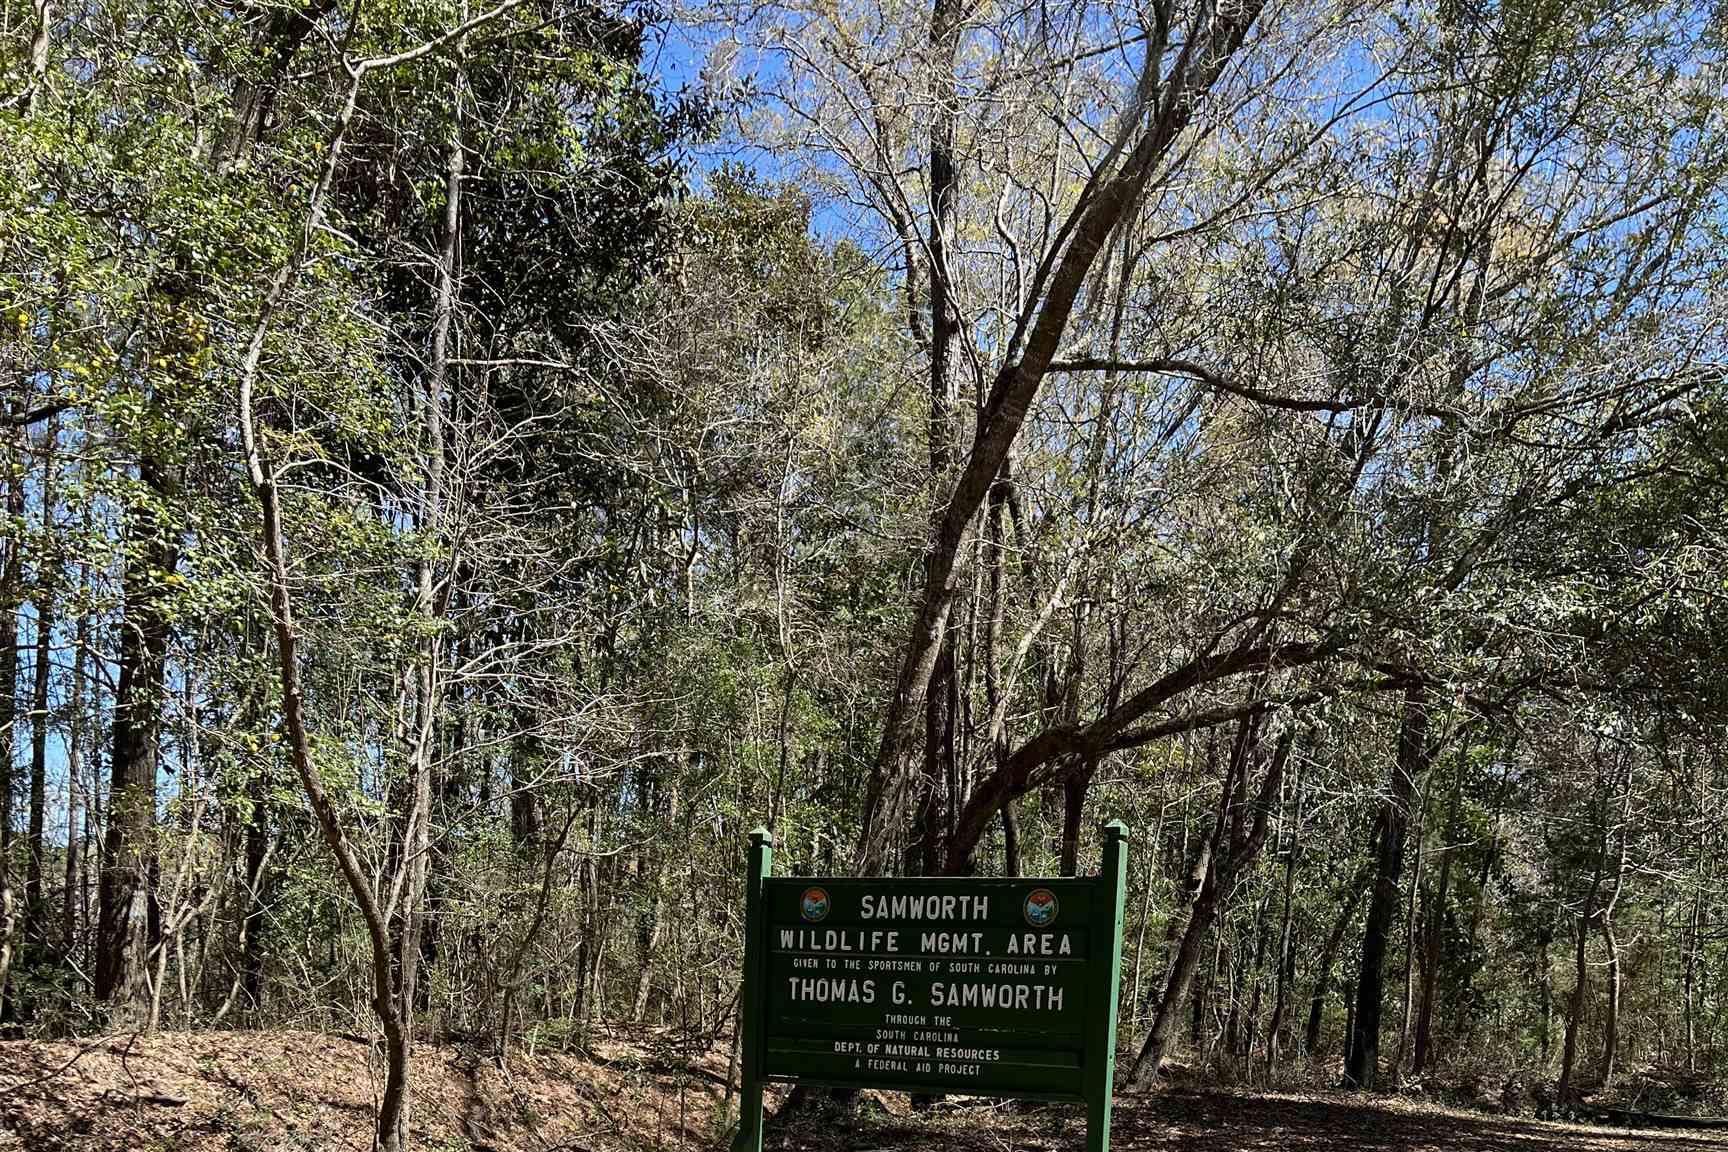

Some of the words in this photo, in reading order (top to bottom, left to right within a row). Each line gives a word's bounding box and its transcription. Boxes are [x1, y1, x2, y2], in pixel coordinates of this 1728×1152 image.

[860, 895, 988, 920] SAMWORTH
[780, 930, 899, 951] WILDLIFE
[921, 933, 991, 955] MGMT.
[1008, 934, 1071, 955] AREA
[793, 958, 818, 968] GIVEN
[826, 959, 836, 969] TO
[845, 959, 861, 970] THE
[868, 960, 921, 972] SPORTSMEN
[929, 962, 940, 972] OF
[949, 962, 980, 973] SOUTH
[988, 963, 1036, 975] CAROLINA
[1045, 965, 1057, 975] BY
[789, 977, 876, 1003] THOMAS
[892, 981, 913, 1005] G.
[931, 983, 1063, 1011] SAMWORTH
[885, 1014, 926, 1025] THROUGH
[934, 1015, 951, 1026] THE
[876, 1030, 906, 1041] SOUTH
[913, 1031, 959, 1043] CAROLINA
[834, 1042, 862, 1053] DEPT.
[867, 1044, 881, 1054] OF
[885, 1045, 930, 1057] NATURAL
[937, 1048, 1000, 1060] RESOURCES
[855, 1058, 861, 1068] A
[868, 1059, 909, 1071] FEDERAL
[916, 1061, 931, 1073] AID
[939, 1062, 980, 1076] PROJECT
